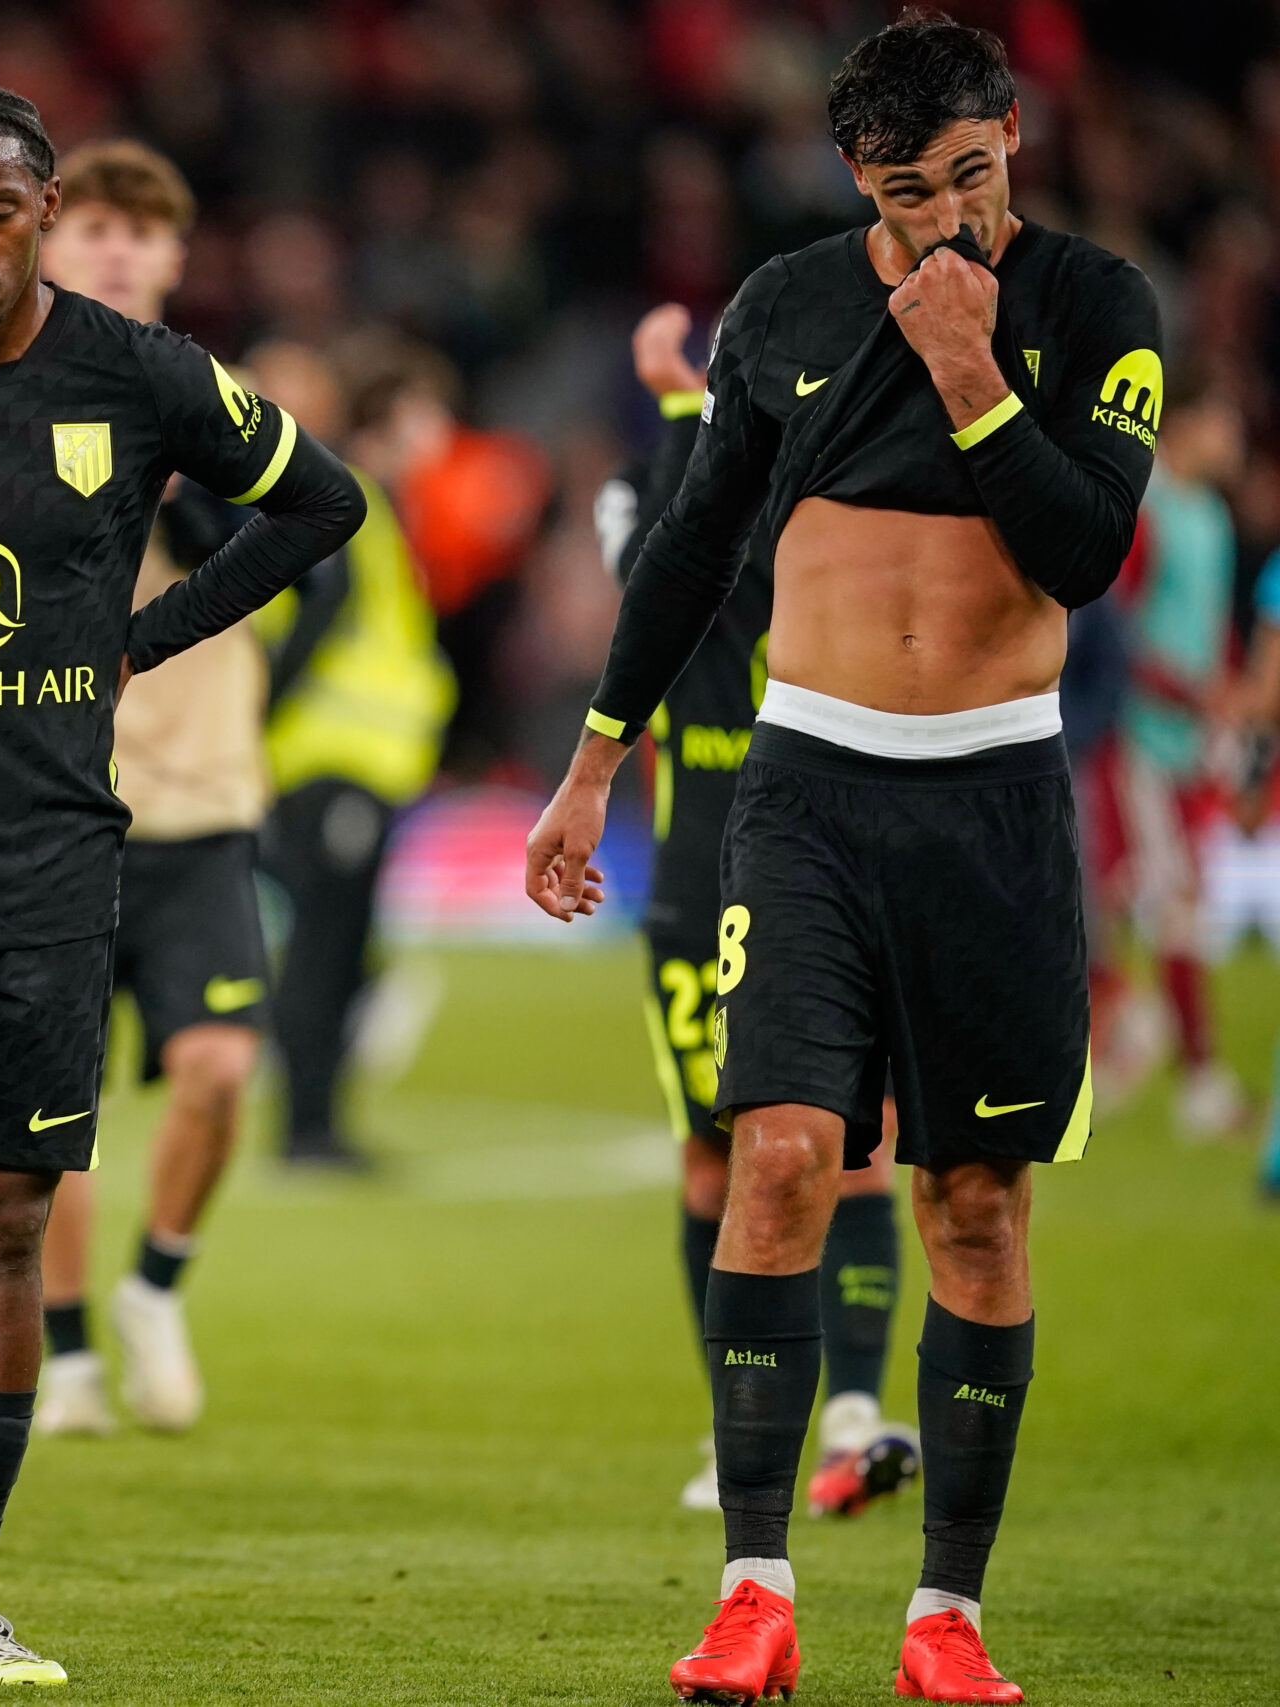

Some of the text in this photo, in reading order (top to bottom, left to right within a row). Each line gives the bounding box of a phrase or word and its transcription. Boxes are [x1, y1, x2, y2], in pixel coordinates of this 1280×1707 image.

[1090, 405, 1156, 455] kraken
[36, 666, 96, 704] AIR
[717, 905, 750, 995] 8
